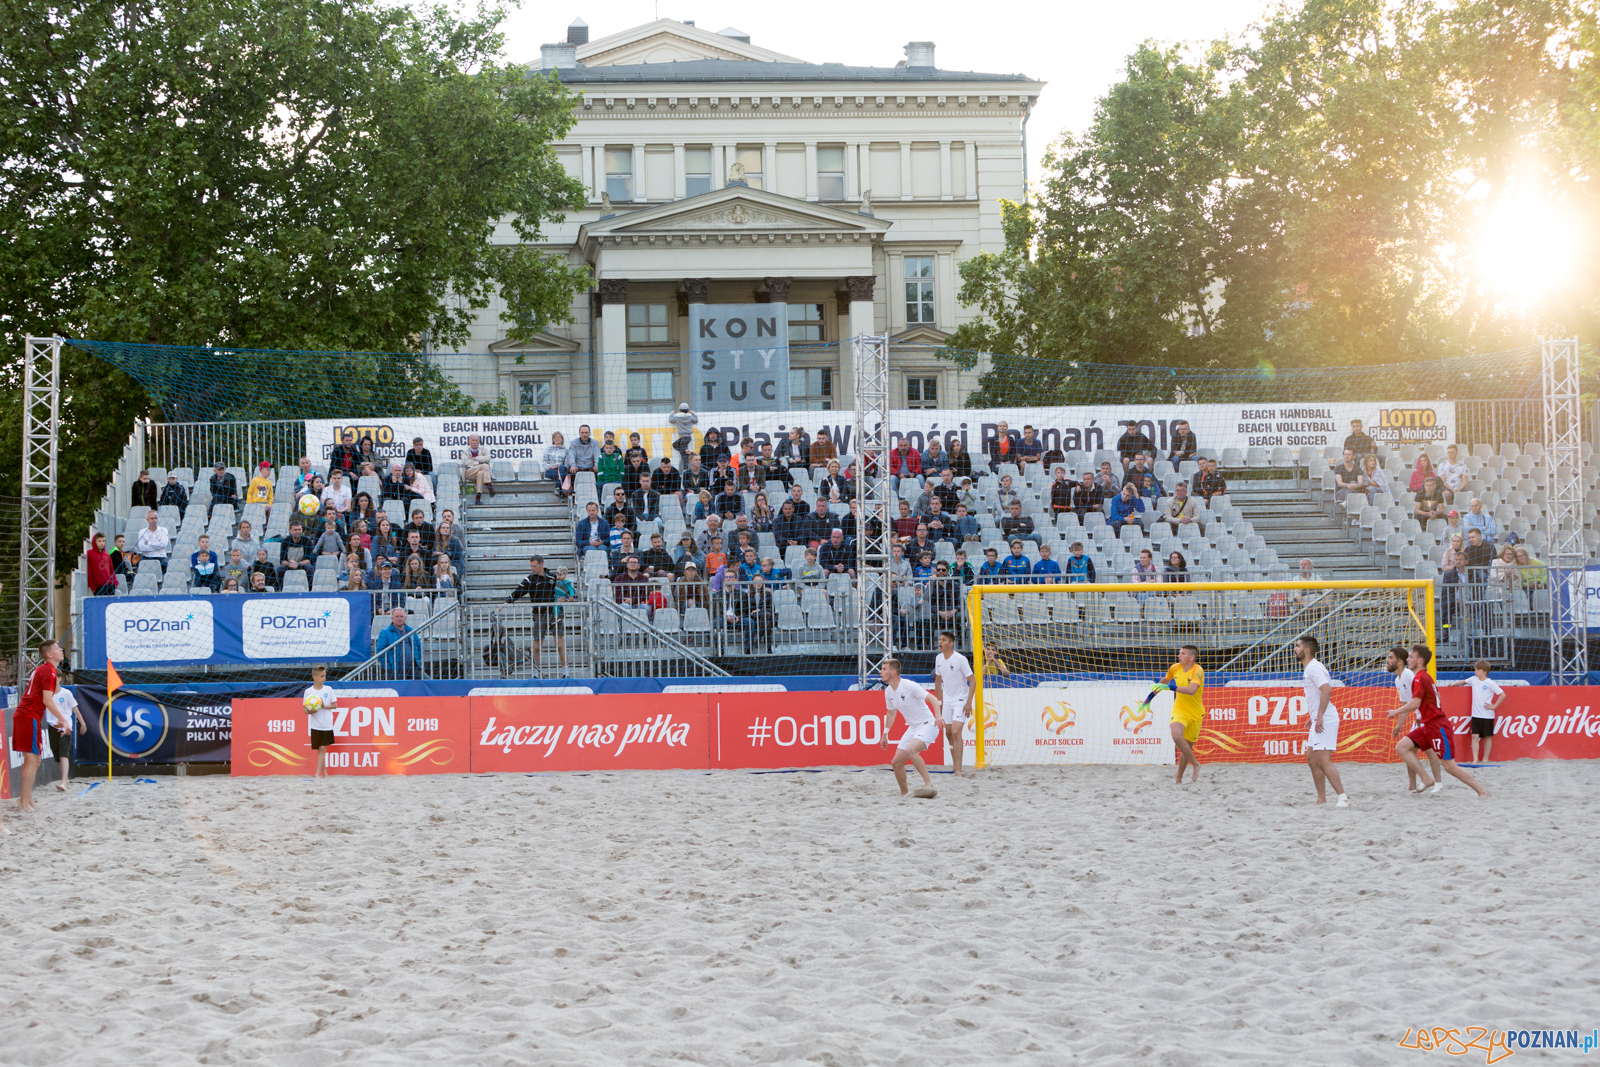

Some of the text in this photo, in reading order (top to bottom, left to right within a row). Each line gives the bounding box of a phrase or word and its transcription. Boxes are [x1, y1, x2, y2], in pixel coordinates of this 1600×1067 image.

[699, 317, 777, 338] KON
[701, 348, 777, 371] STY
[702, 379, 776, 401] TUC
[1241, 408, 1333, 420] BEACH HANDBALL
[1380, 409, 1436, 427] LOTTO
[443, 420, 539, 433] BEACH HANDBALL
[1237, 421, 1337, 433] BEACH VOLLEYBALL
[1369, 426, 1399, 440] Plaża
[1400, 425, 1446, 440] Wolności
[479, 434, 543, 446] VOLLEYBALL
[1248, 435, 1327, 446] BEACH SOCCER
[489, 448, 533, 460] SOCCER
[1208, 707, 1237, 721] 1919
[1247, 695, 1310, 726] PZP
[1342, 707, 1373, 721] 2019
[266, 719, 296, 733] 1919
[307, 706, 395, 737] ZPN
[407, 718, 439, 732] 2019
[1493, 714, 1541, 739] nas
[186, 731, 215, 741] PIŁKI
[479, 713, 690, 758] Łączy nas piłka
[1035, 738, 1084, 746] BEACH SOCCER
[1135, 737, 1162, 745] SOCCER
[1262, 740, 1309, 755] 100 LA
[1432, 738, 1442, 750] 17
[324, 751, 381, 768] 100 LAT
